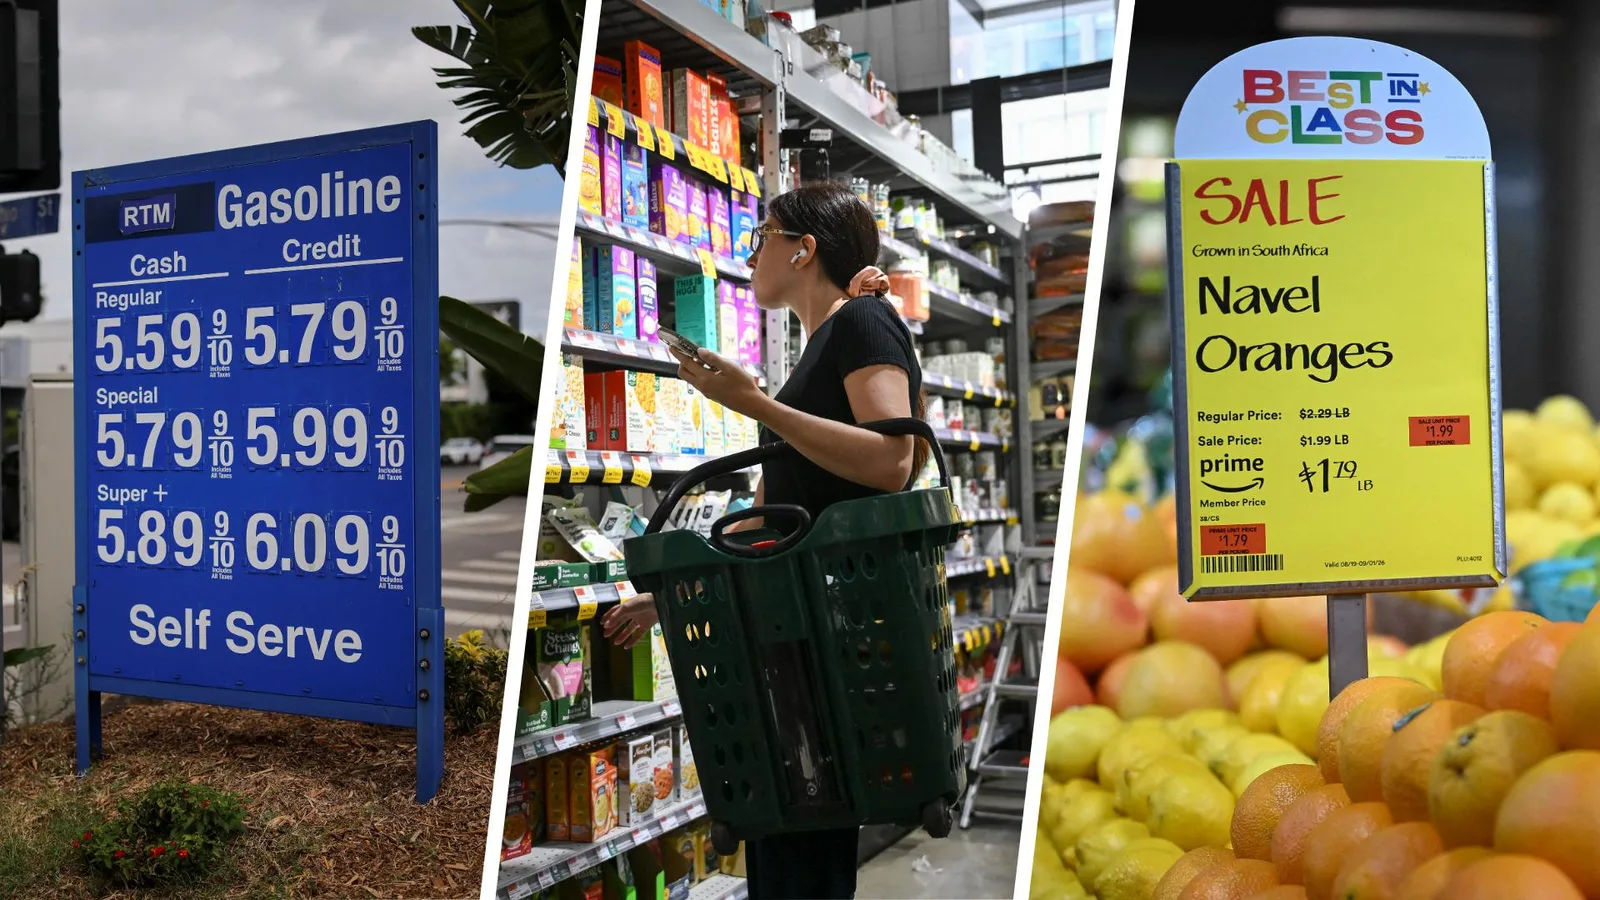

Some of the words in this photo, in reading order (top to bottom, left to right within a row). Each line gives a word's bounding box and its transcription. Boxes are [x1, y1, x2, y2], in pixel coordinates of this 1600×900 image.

[1243, 69, 1383, 109] BEST
[1389, 79, 1418, 97] IN
[1245, 105, 1424, 145] CLASS
[217, 170, 401, 230] Gasoline
[1194, 175, 1346, 227] SALE
[124, 202, 170, 227] RTM
[283, 234, 361, 263] Credit
[1192, 244, 1236, 257] Grown
[1238, 245, 1250, 256] in
[1252, 245, 1290, 257] South
[1292, 244, 1329, 257] Africa
[130, 251, 187, 277] Cash
[676, 279, 693, 288] THIS
[676, 286, 697, 296] HUGE
[1199, 275, 1320, 315] Navel
[96, 288, 162, 312] Regular
[380, 297, 398, 325] 9
[212, 309, 227, 335] 9
[245, 300, 367, 365] 5.79
[95, 312, 201, 372] 5.59
[207, 339, 233, 366] 10
[374, 330, 404, 359] 10
[1195, 335, 1393, 382] Oranges
[96, 386, 158, 408] Special
[213, 410, 228, 436] 9
[381, 406, 398, 434] 9
[1198, 411, 1244, 424] Regular
[1248, 410, 1282, 421] Price:
[1299, 408, 1332, 420] $2.29
[1335, 408, 1350, 418] LB
[96, 412, 203, 468] 5.79
[246, 407, 368, 468] 5.99
[1198, 436, 1224, 447] Sale
[1228, 435, 1262, 445] Price:
[1300, 435, 1331, 447] $1.99
[1335, 435, 1349, 445] LB
[1426, 424, 1454, 438] $1.99
[208, 440, 234, 467] 10
[375, 438, 405, 467] 10
[1200, 453, 1264, 477] prime
[97, 484, 148, 505] Super
[153, 484, 168, 502] +
[1357, 480, 1373, 491] LB
[1200, 499, 1240, 508] Member
[1242, 498, 1266, 507] Price
[214, 510, 229, 537] 9
[382, 515, 399, 544] 9
[97, 509, 203, 567] 5.89
[246, 512, 370, 575] 6.09
[1219, 533, 1248, 547] $1.79
[209, 541, 235, 568] 10
[376, 547, 406, 577] 10
[129, 604, 211, 650] Self
[225, 610, 363, 663] Serve
